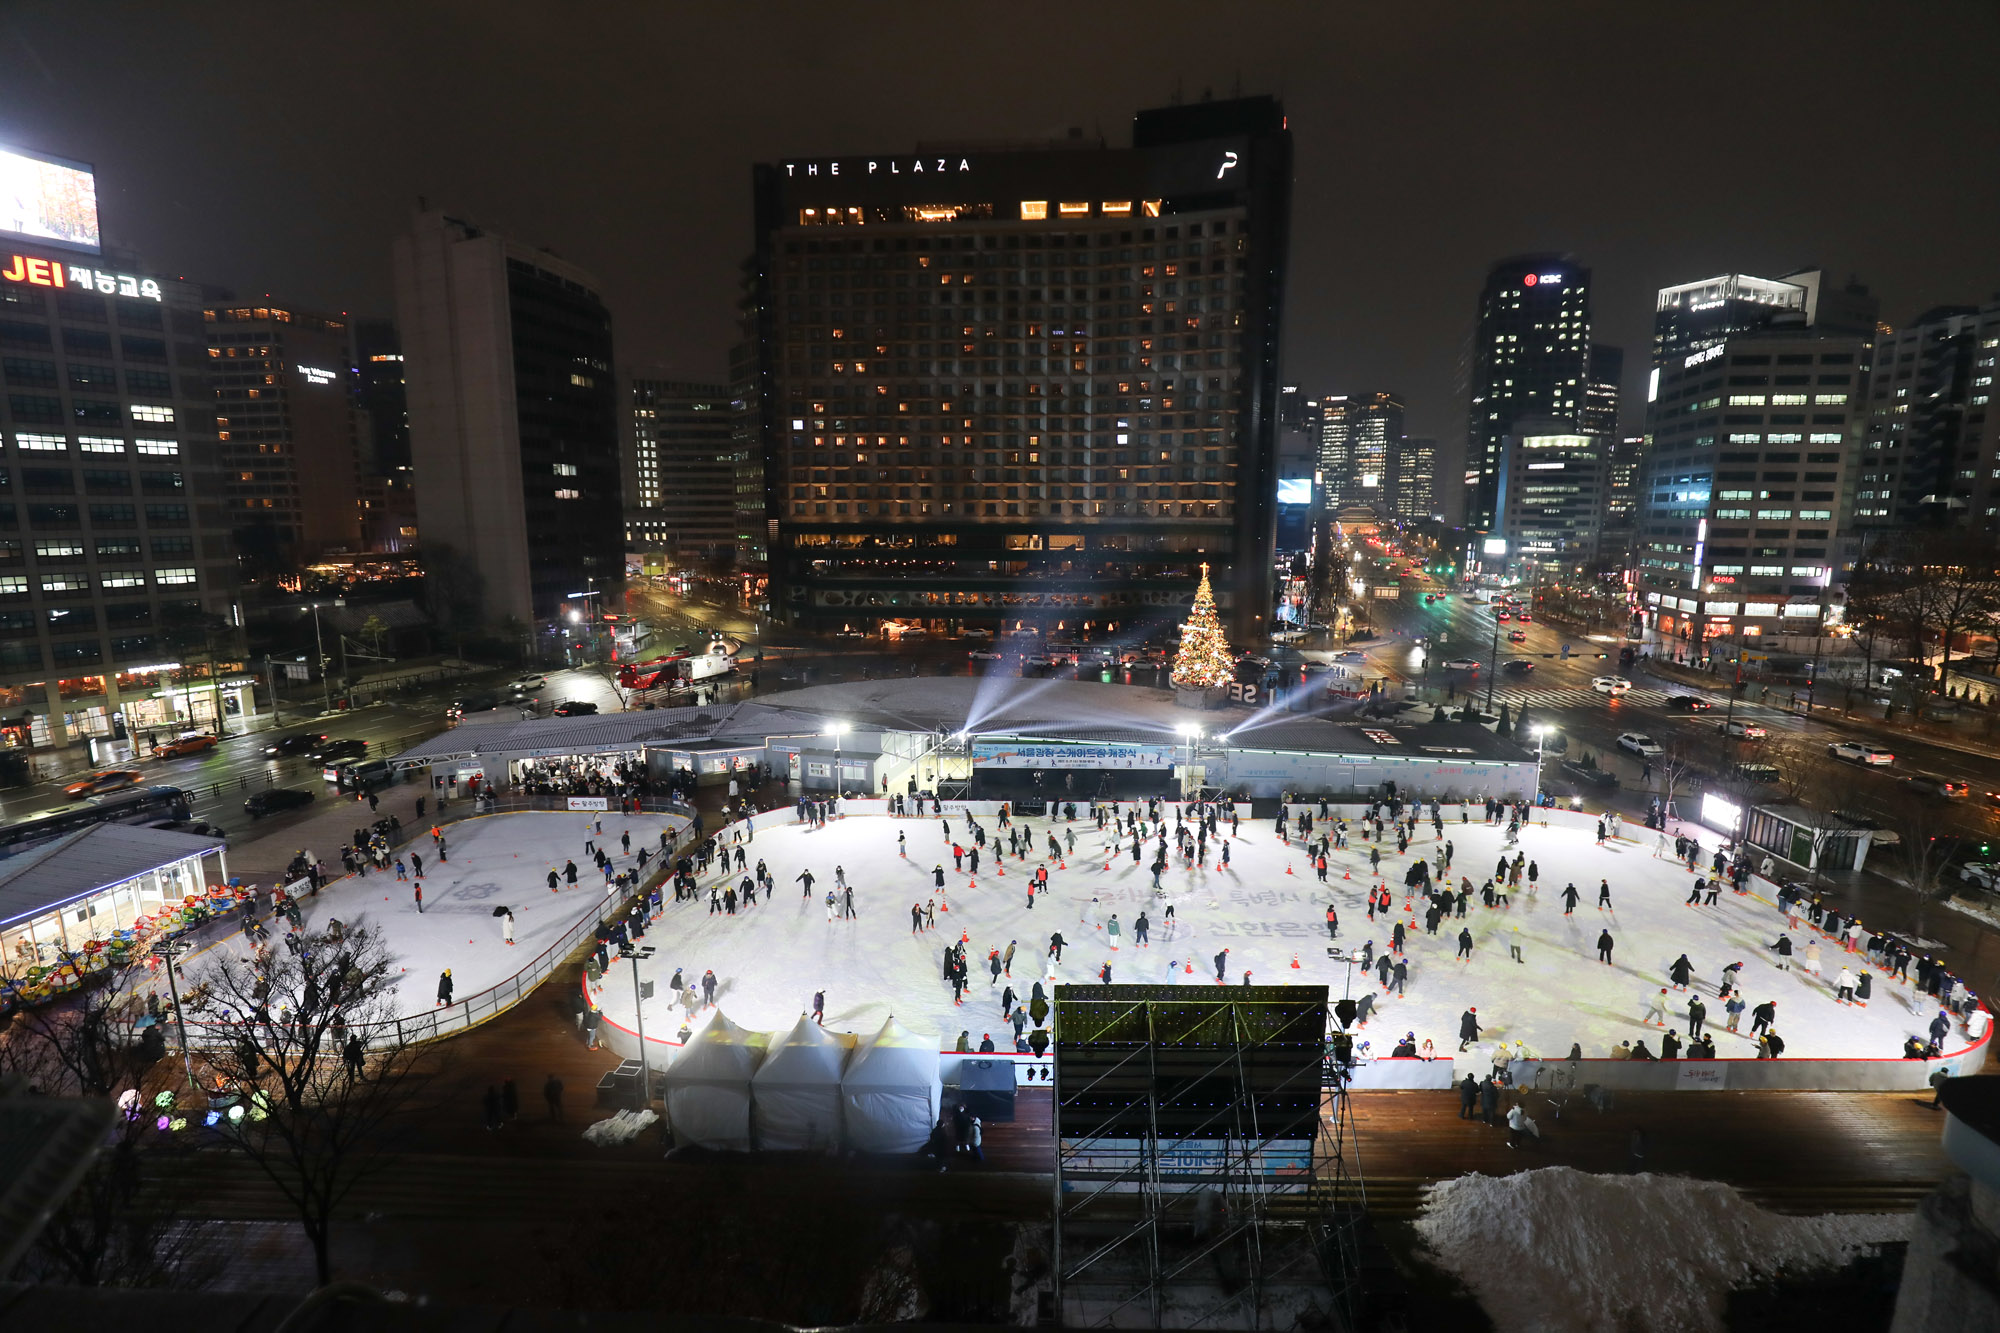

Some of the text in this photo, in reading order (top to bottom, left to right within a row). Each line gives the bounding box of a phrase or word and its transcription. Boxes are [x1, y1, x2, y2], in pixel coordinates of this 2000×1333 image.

[786, 158, 970, 177] THE PLAZA
[2, 255, 65, 288] JEI
[69, 266, 162, 302] 재능교육
[1712, 576, 1736, 584] 다이소
[1016, 748, 1055, 758] 서울광장
[1056, 748, 1107, 758] 스케이트장
[1108, 748, 1137, 758] 개장식
